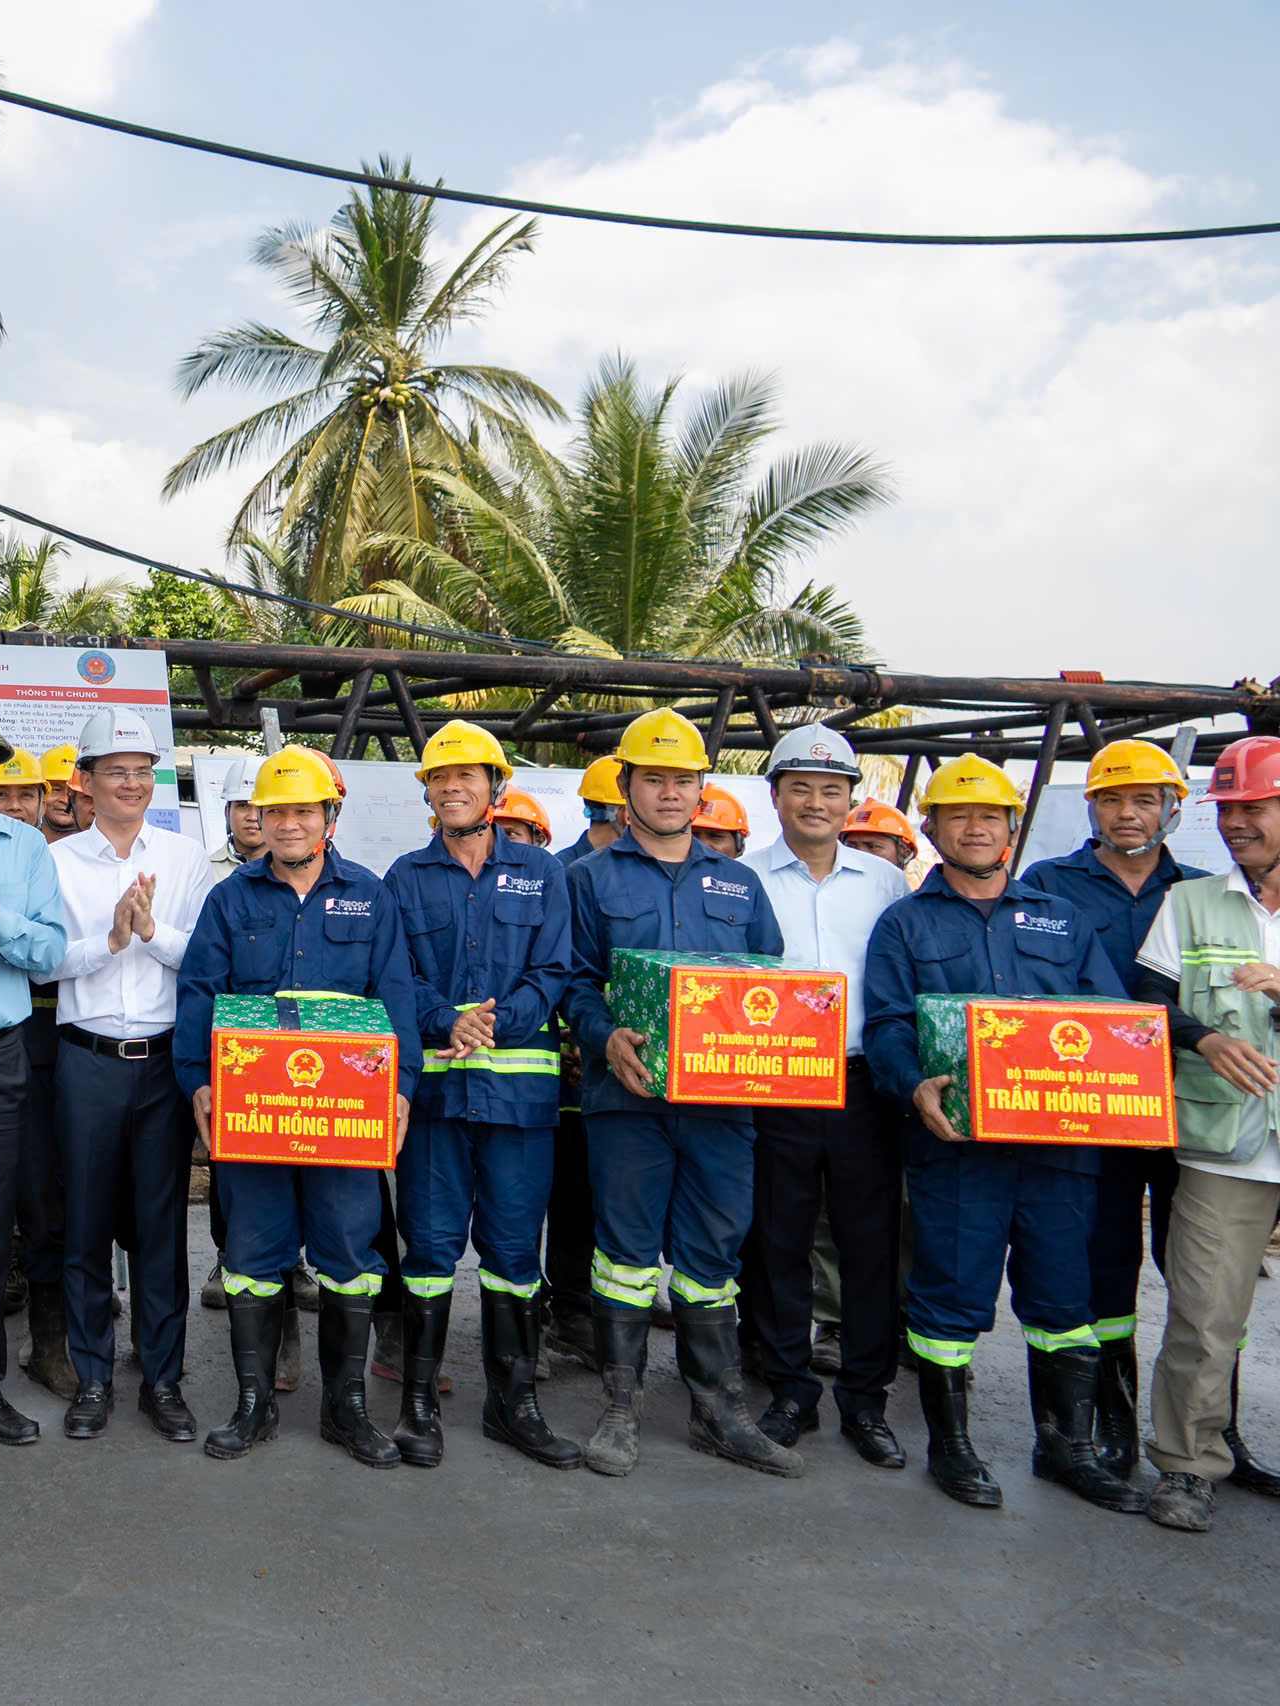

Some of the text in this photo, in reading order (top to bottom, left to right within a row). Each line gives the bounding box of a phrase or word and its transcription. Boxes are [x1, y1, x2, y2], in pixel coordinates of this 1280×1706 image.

[15, 688, 48, 697] THÔNG
[702, 1031, 716, 1046] BỘ
[756, 1033, 769, 1048] BỘ
[771, 1034, 789, 1047] XÂY
[791, 1036, 817, 1050] DỰNG
[683, 1045, 835, 1077] TRẦN HỒNG MINH
[1006, 1066, 1022, 1082] BỘ
[1068, 1069, 1083, 1085] BỘ
[1085, 1070, 1106, 1084] XÂY
[1108, 1072, 1139, 1087] DỰNG
[744, 1080, 772, 1094] Tặng
[245, 1092, 258, 1107] BỘ
[300, 1095, 314, 1110] BỘ
[316, 1095, 336, 1109] XÂY
[337, 1098, 365, 1112] DỰNG
[985, 1083, 1163, 1117] TRẦN HỒNG MINH
[225, 1107, 384, 1139] TRẦN HỒNG MINH
[1058, 1119, 1090, 1133] Tặng
[289, 1140, 317, 1154] Tặng
